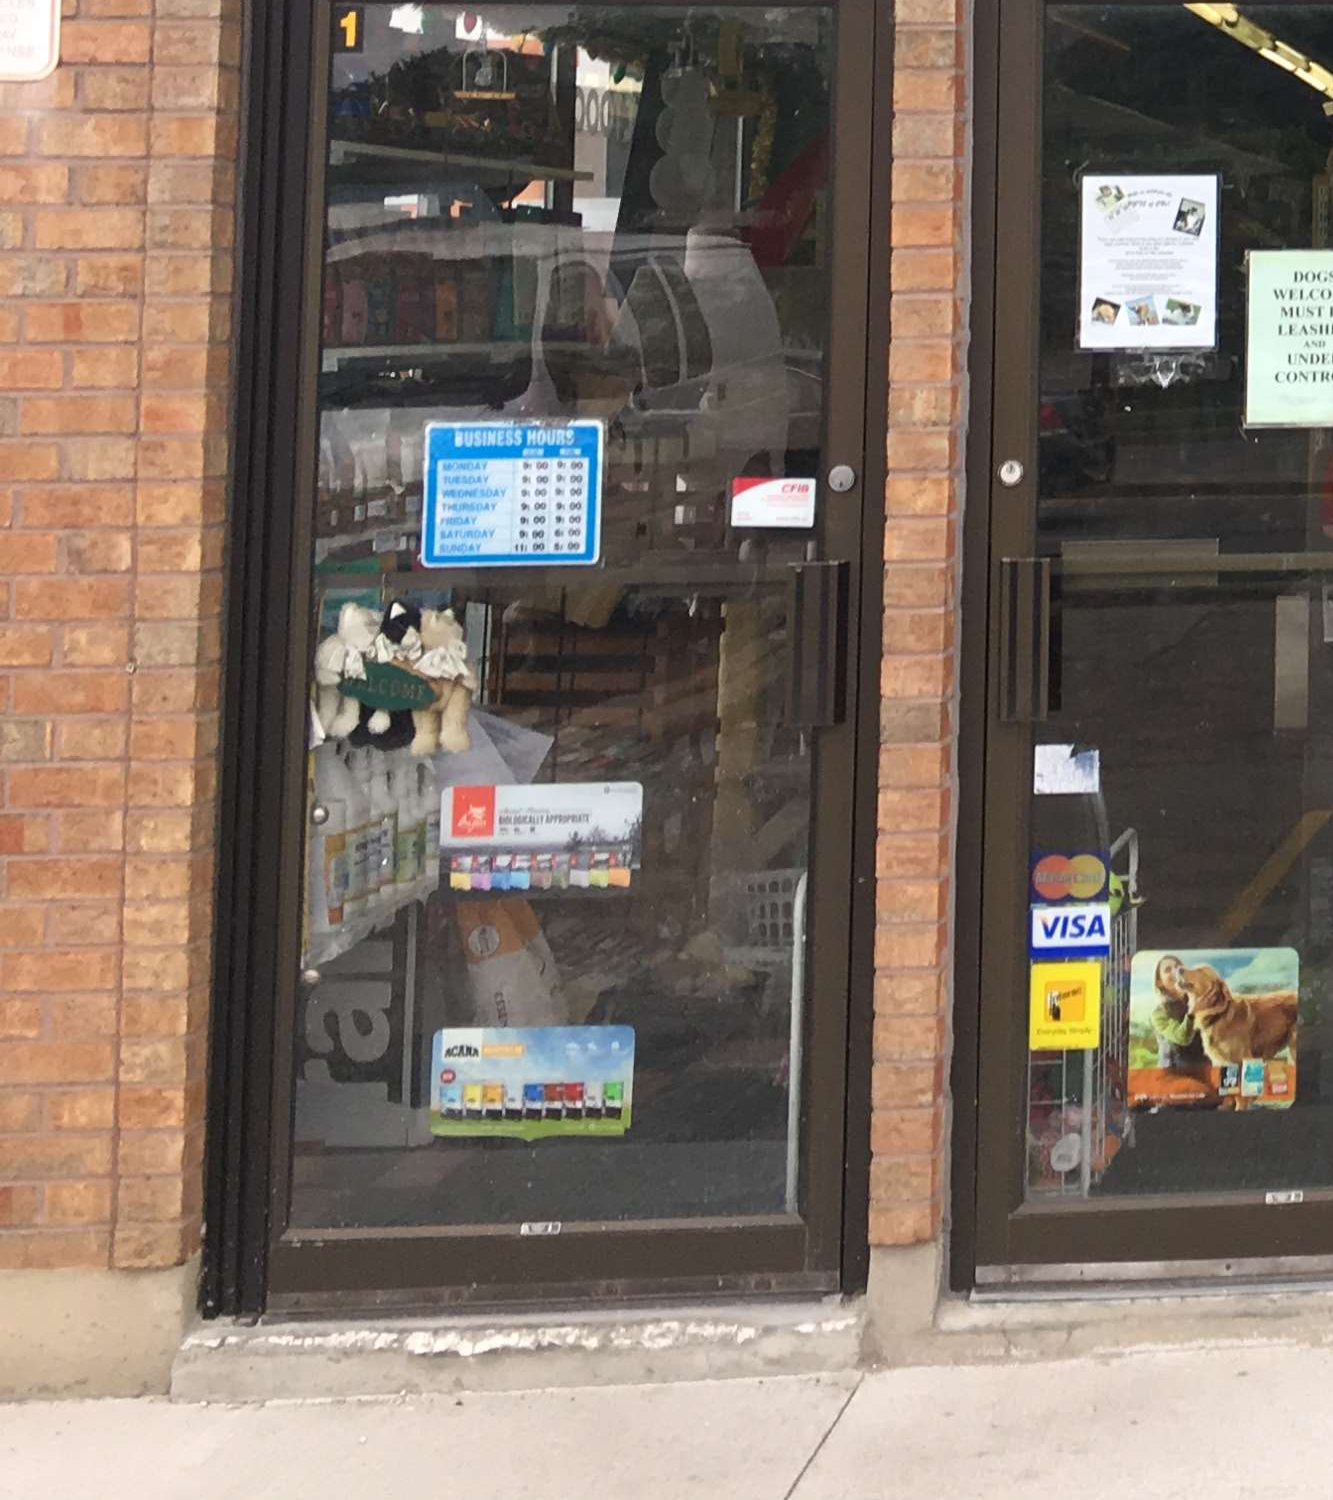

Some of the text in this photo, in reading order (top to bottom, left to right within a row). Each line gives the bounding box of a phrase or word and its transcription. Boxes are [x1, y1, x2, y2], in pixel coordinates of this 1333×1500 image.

[341, 11, 358, 48] 1
[1281, 306, 1324, 318] MUST
[1303, 340, 1326, 349] AND
[455, 429, 575, 447] BUSINESS HOURS
[1040, 914, 1105, 939] VISA
